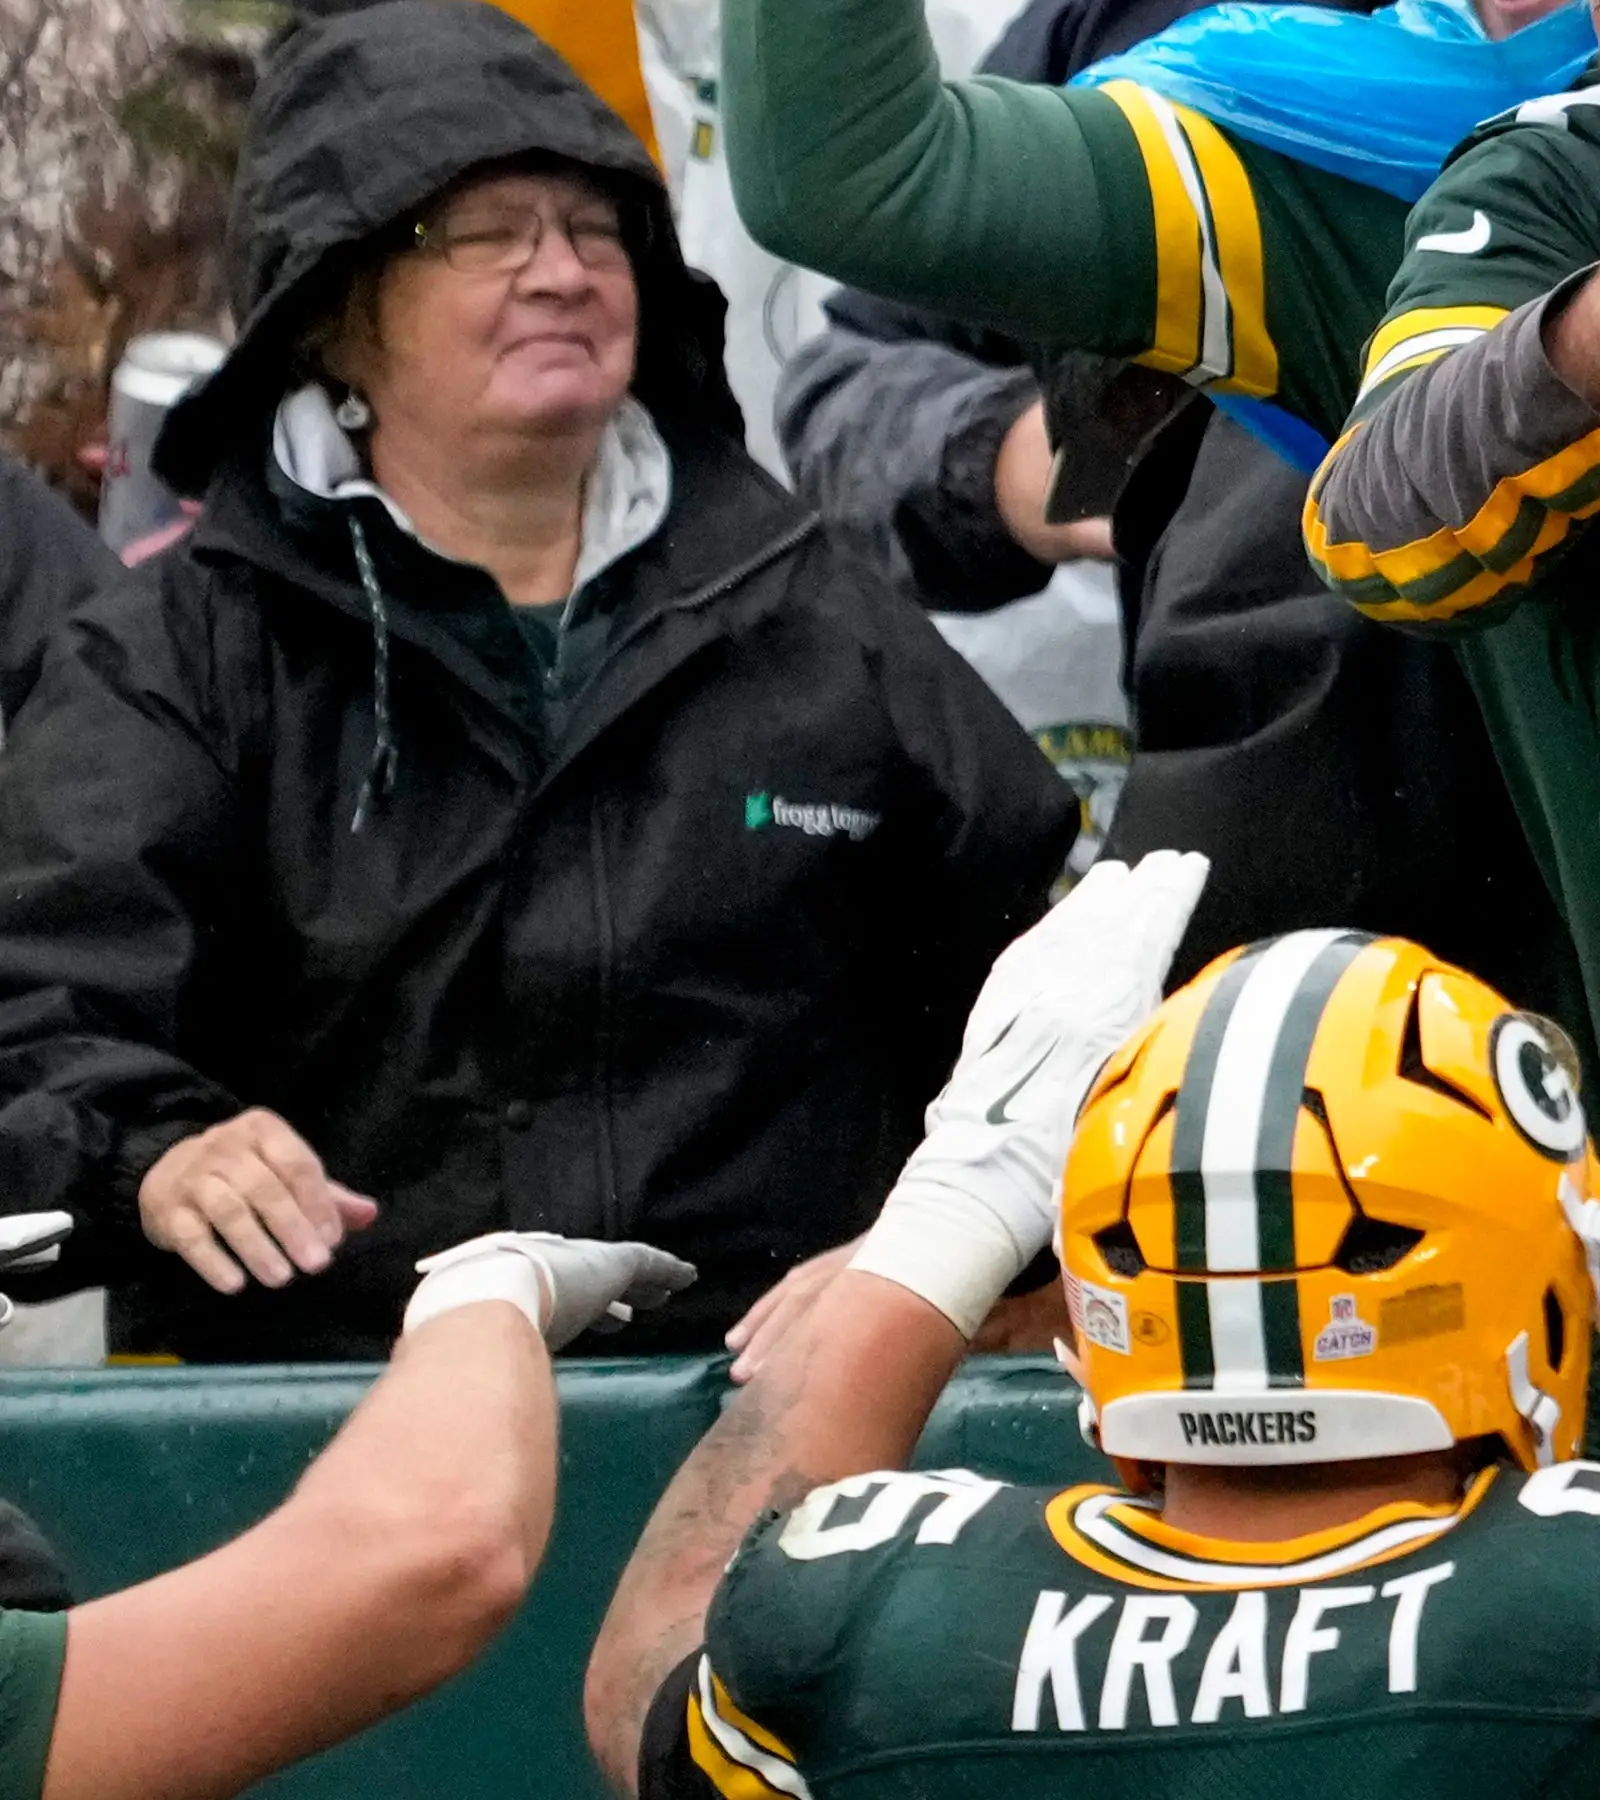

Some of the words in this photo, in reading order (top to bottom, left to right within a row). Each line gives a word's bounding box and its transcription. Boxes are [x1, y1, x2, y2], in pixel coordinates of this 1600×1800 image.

[773, 795, 834, 837] frogg
[1490, 1013, 1586, 1164] G
[1178, 1411, 1316, 1446] PACKERS
[1012, 1561, 1456, 1732] KRAFT
